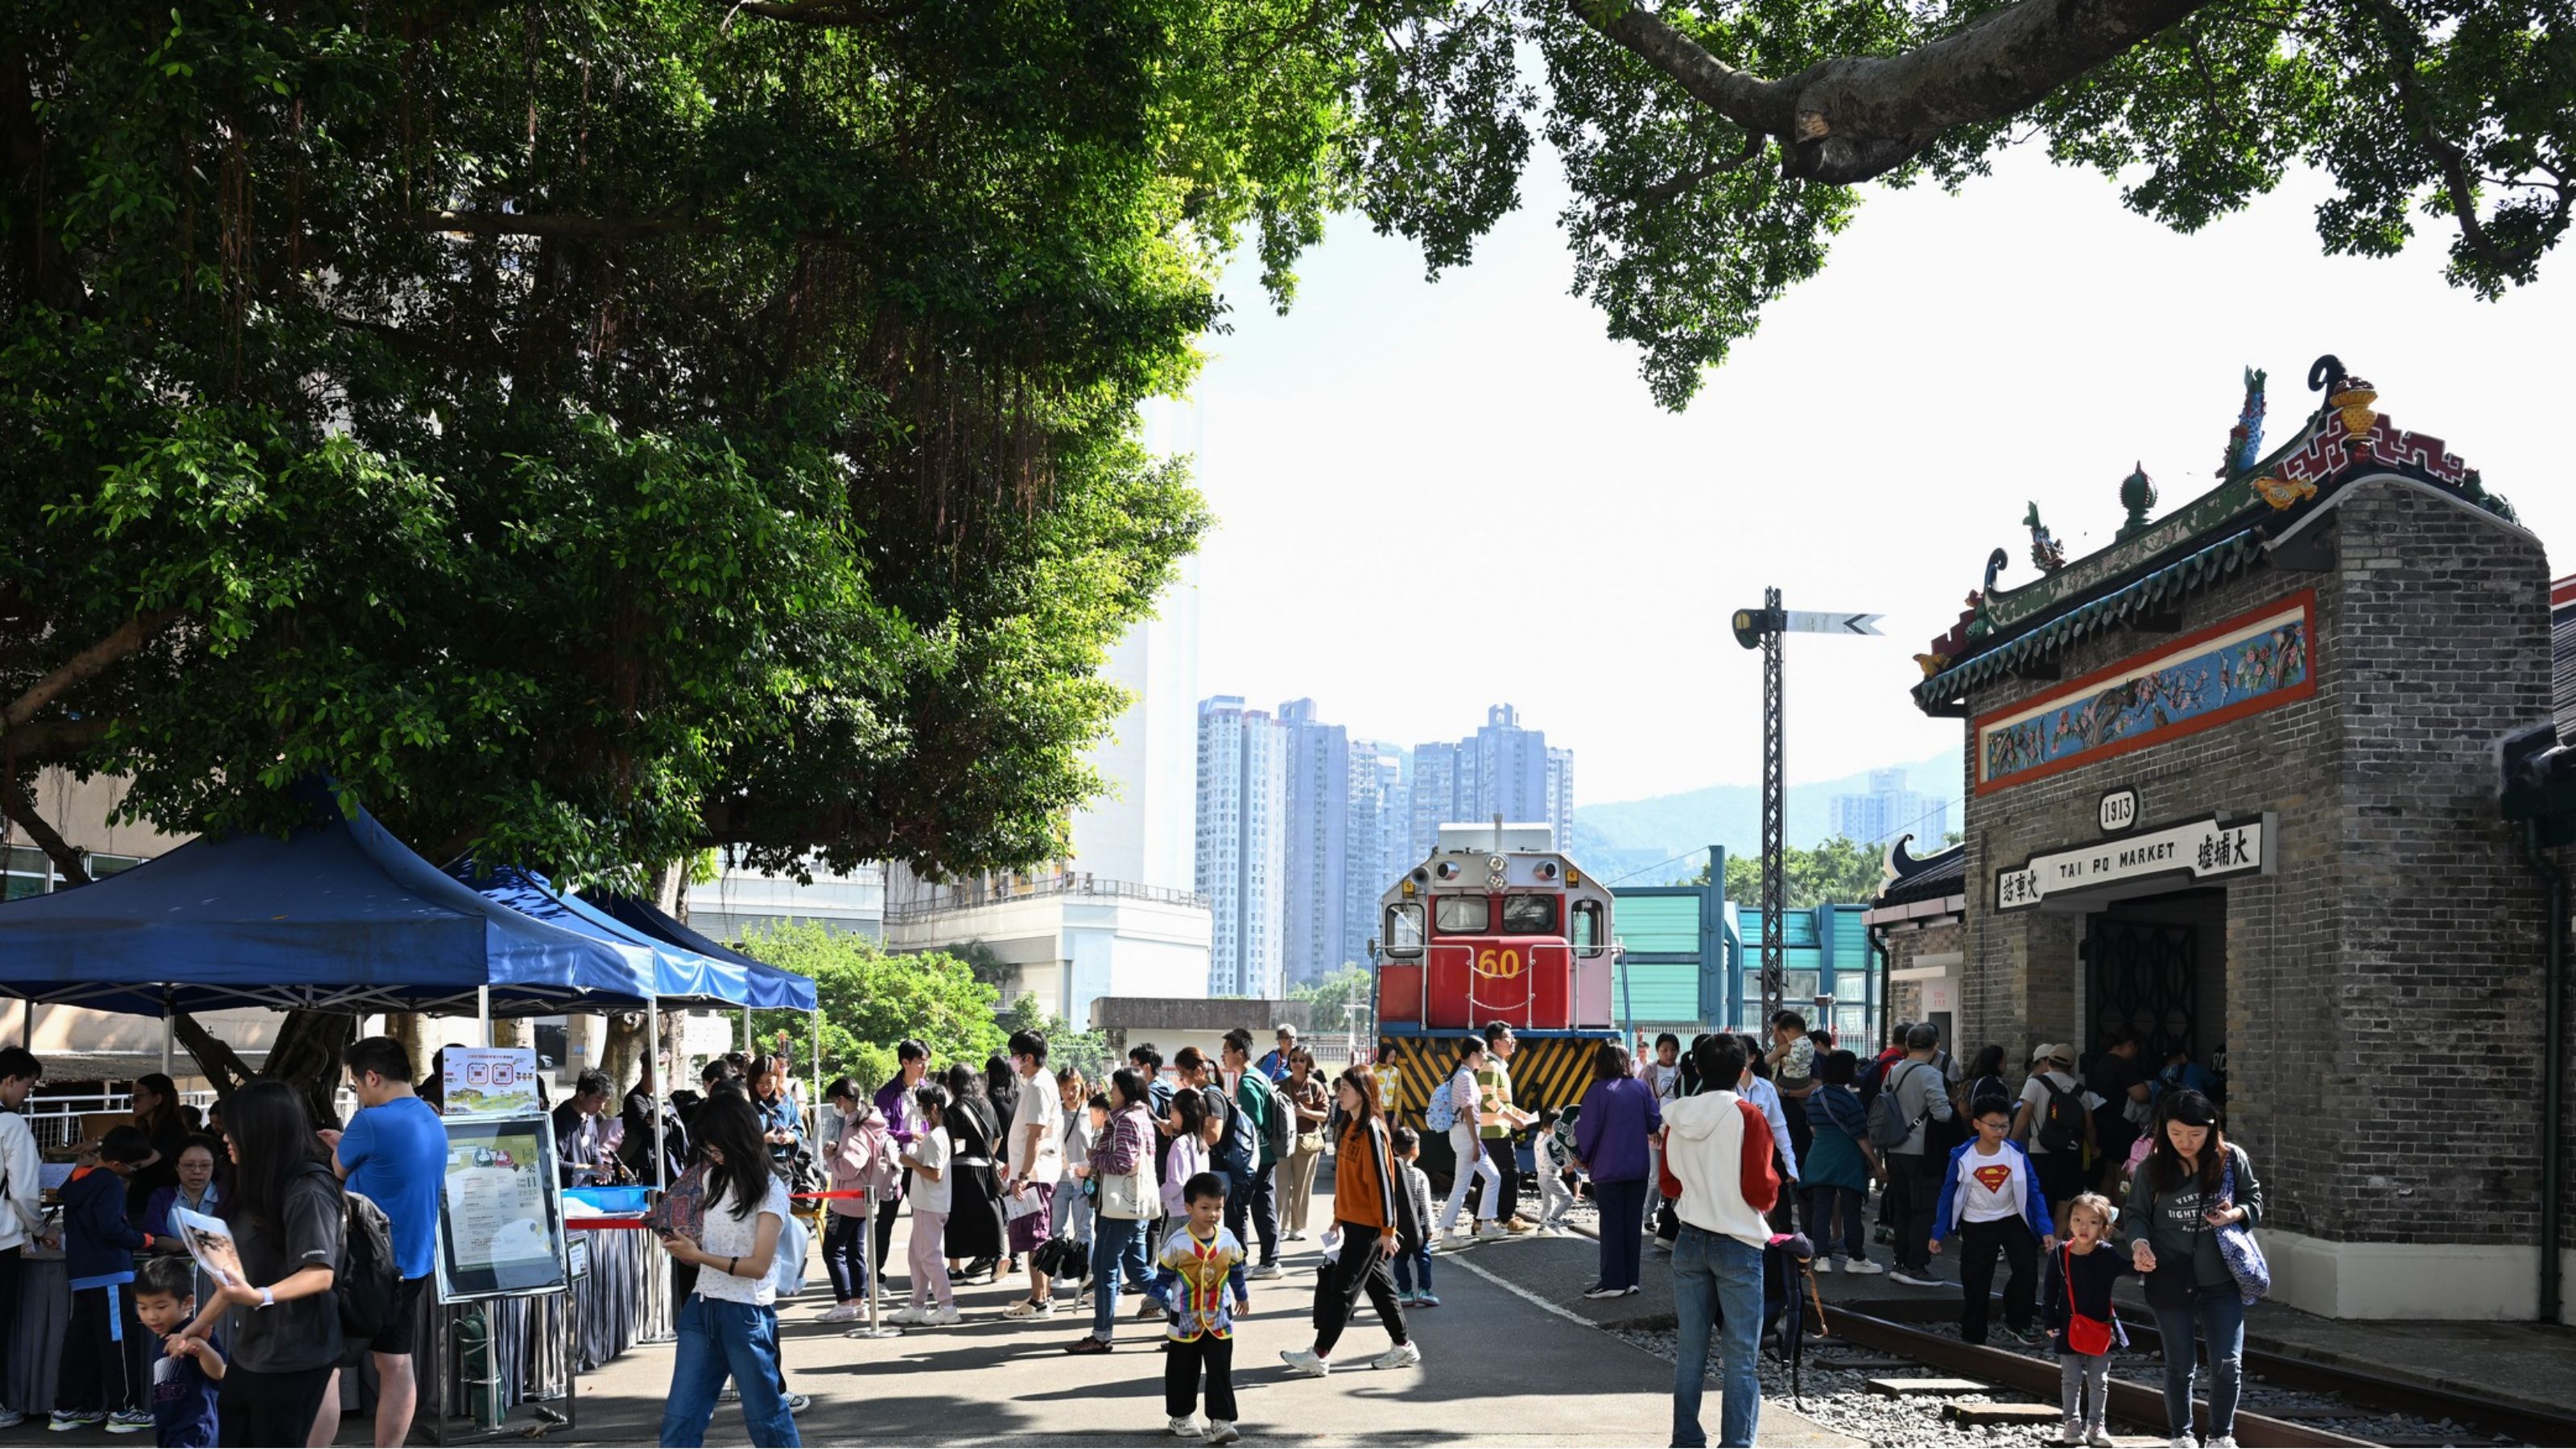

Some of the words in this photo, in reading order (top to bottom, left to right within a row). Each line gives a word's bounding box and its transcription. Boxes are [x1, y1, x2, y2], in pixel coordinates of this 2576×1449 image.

[2105, 796, 2132, 823] 1913
[2060, 862, 2082, 878] TAI
[2093, 857, 2109, 873] PO
[2120, 842, 2174, 868] MARKET
[1479, 949, 1520, 979] 60
